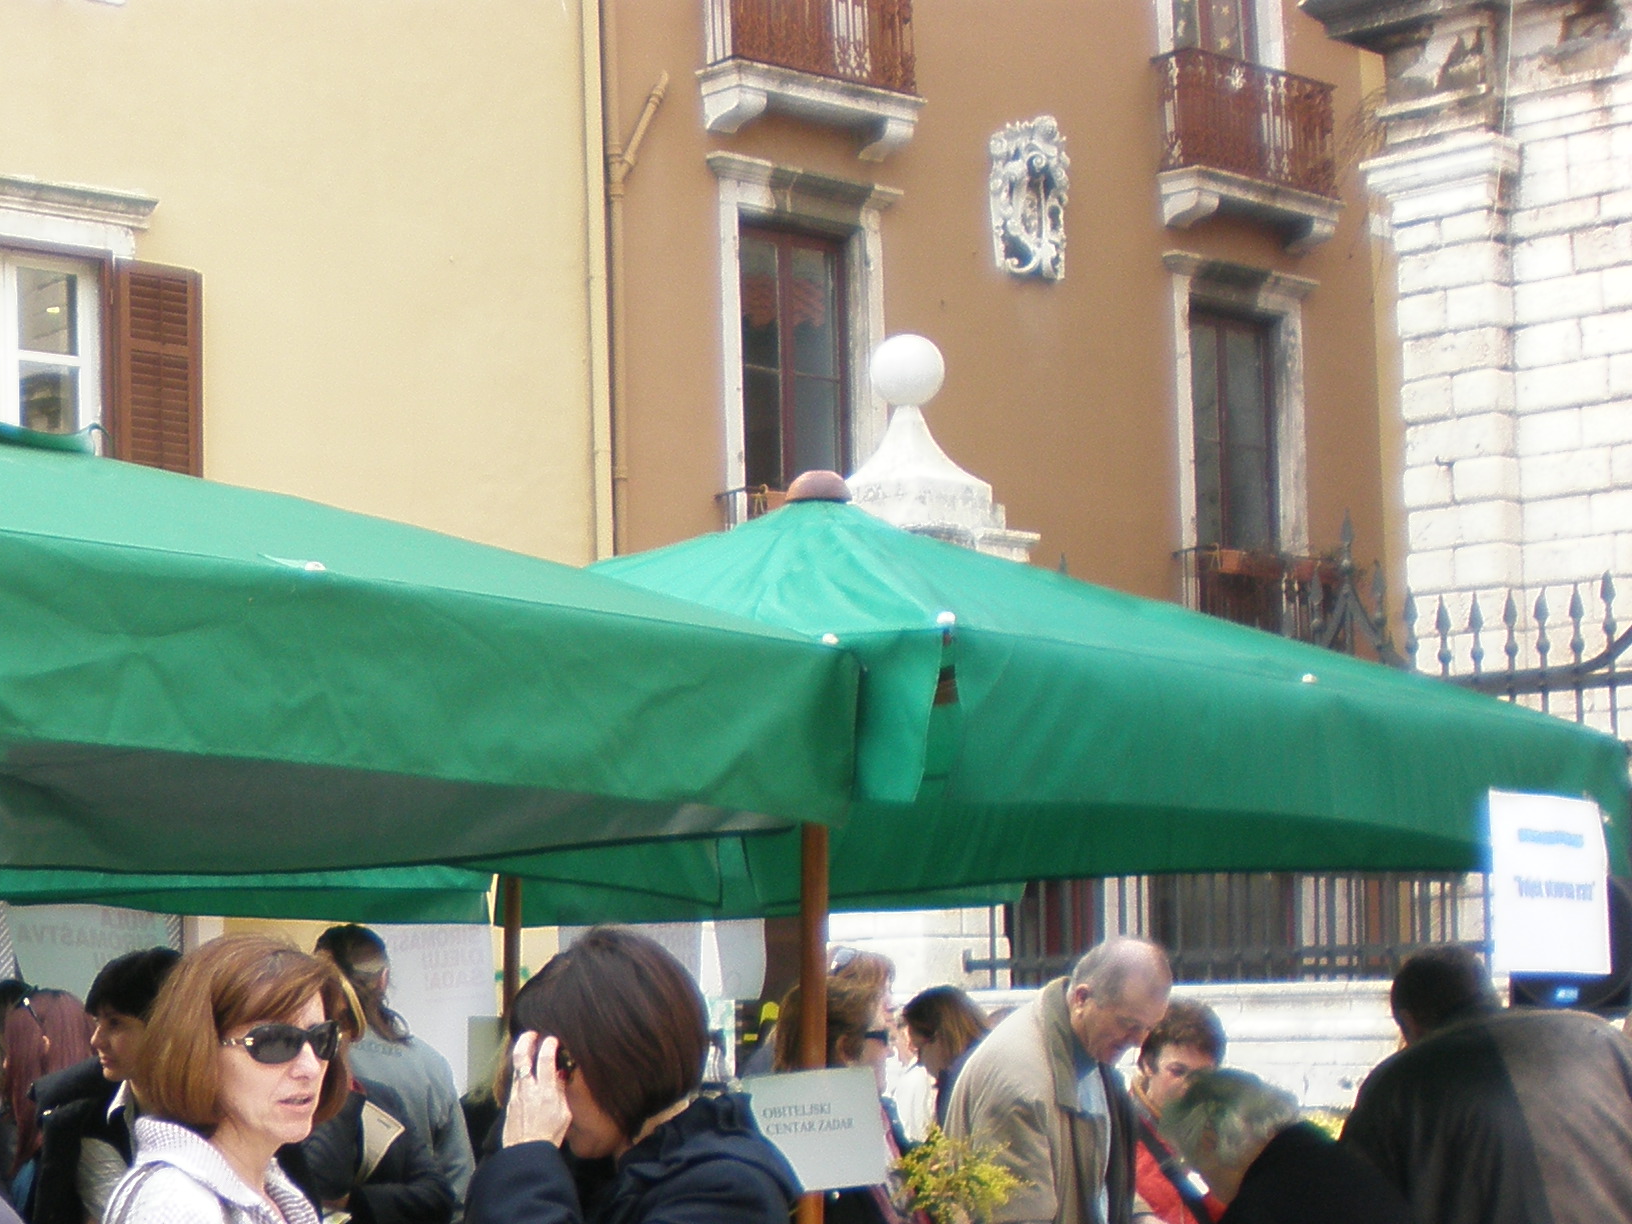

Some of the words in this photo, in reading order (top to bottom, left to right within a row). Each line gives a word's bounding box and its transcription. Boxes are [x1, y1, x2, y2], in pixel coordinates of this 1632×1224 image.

[762, 1102, 831, 1119] OBITELJSKI
[766, 1120, 815, 1135] CENTAR
[817, 1117, 854, 1132] ZADAR
